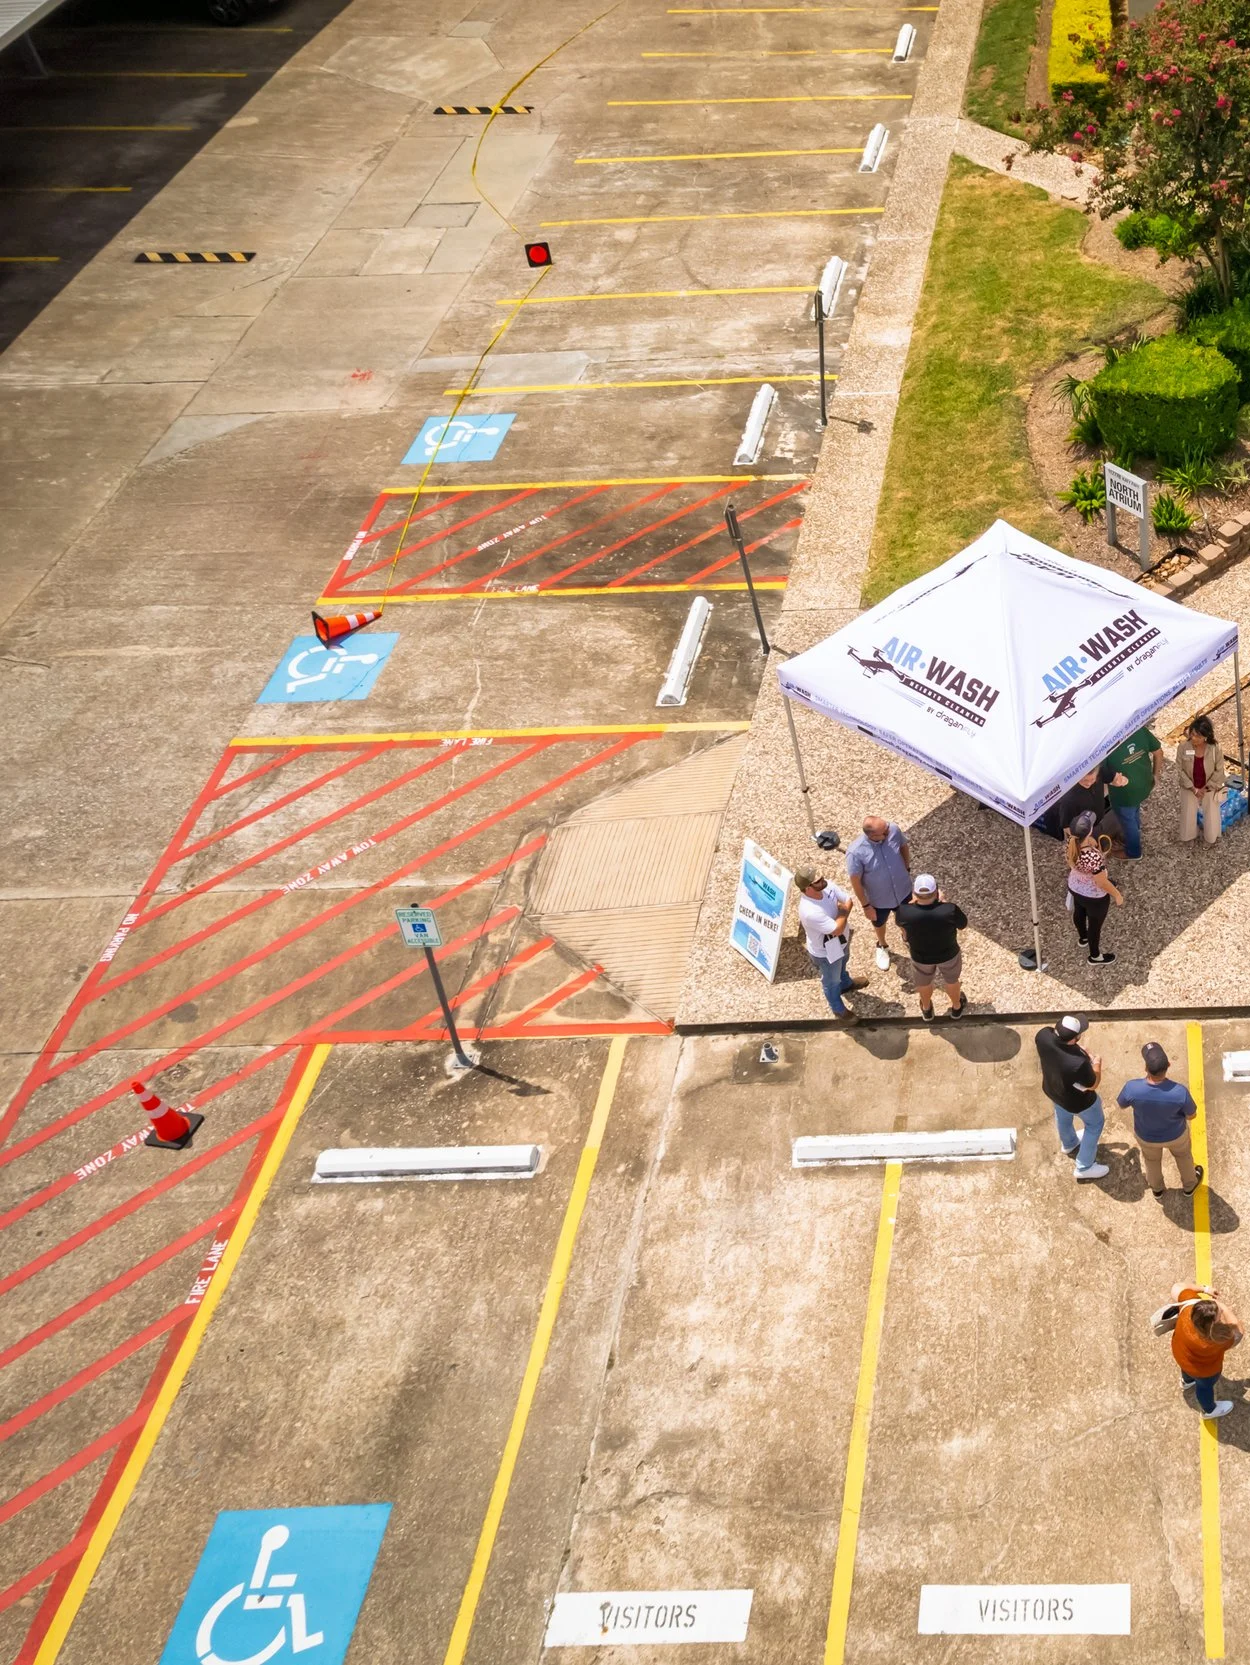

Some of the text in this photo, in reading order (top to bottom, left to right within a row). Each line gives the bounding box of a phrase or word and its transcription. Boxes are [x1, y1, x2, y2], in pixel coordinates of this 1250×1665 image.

[1109, 488, 1142, 513] ATRIUM
[1110, 478, 1139, 501] NORTH
[1127, 664, 1134, 672] BY
[926, 706, 934, 714] BY
[440, 737, 466, 747] LANE
[280, 838, 377, 894] TOW AWAY ZONE
[739, 904, 779, 932] CHECK IN HERE!
[99, 913, 140, 962] NO PARKING
[73, 1149, 117, 1181] ZONE
[184, 1239, 229, 1305] FIRE LANE
[600, 1601, 697, 1629] VISITORS
[979, 1598, 1074, 1623] VISITORS
